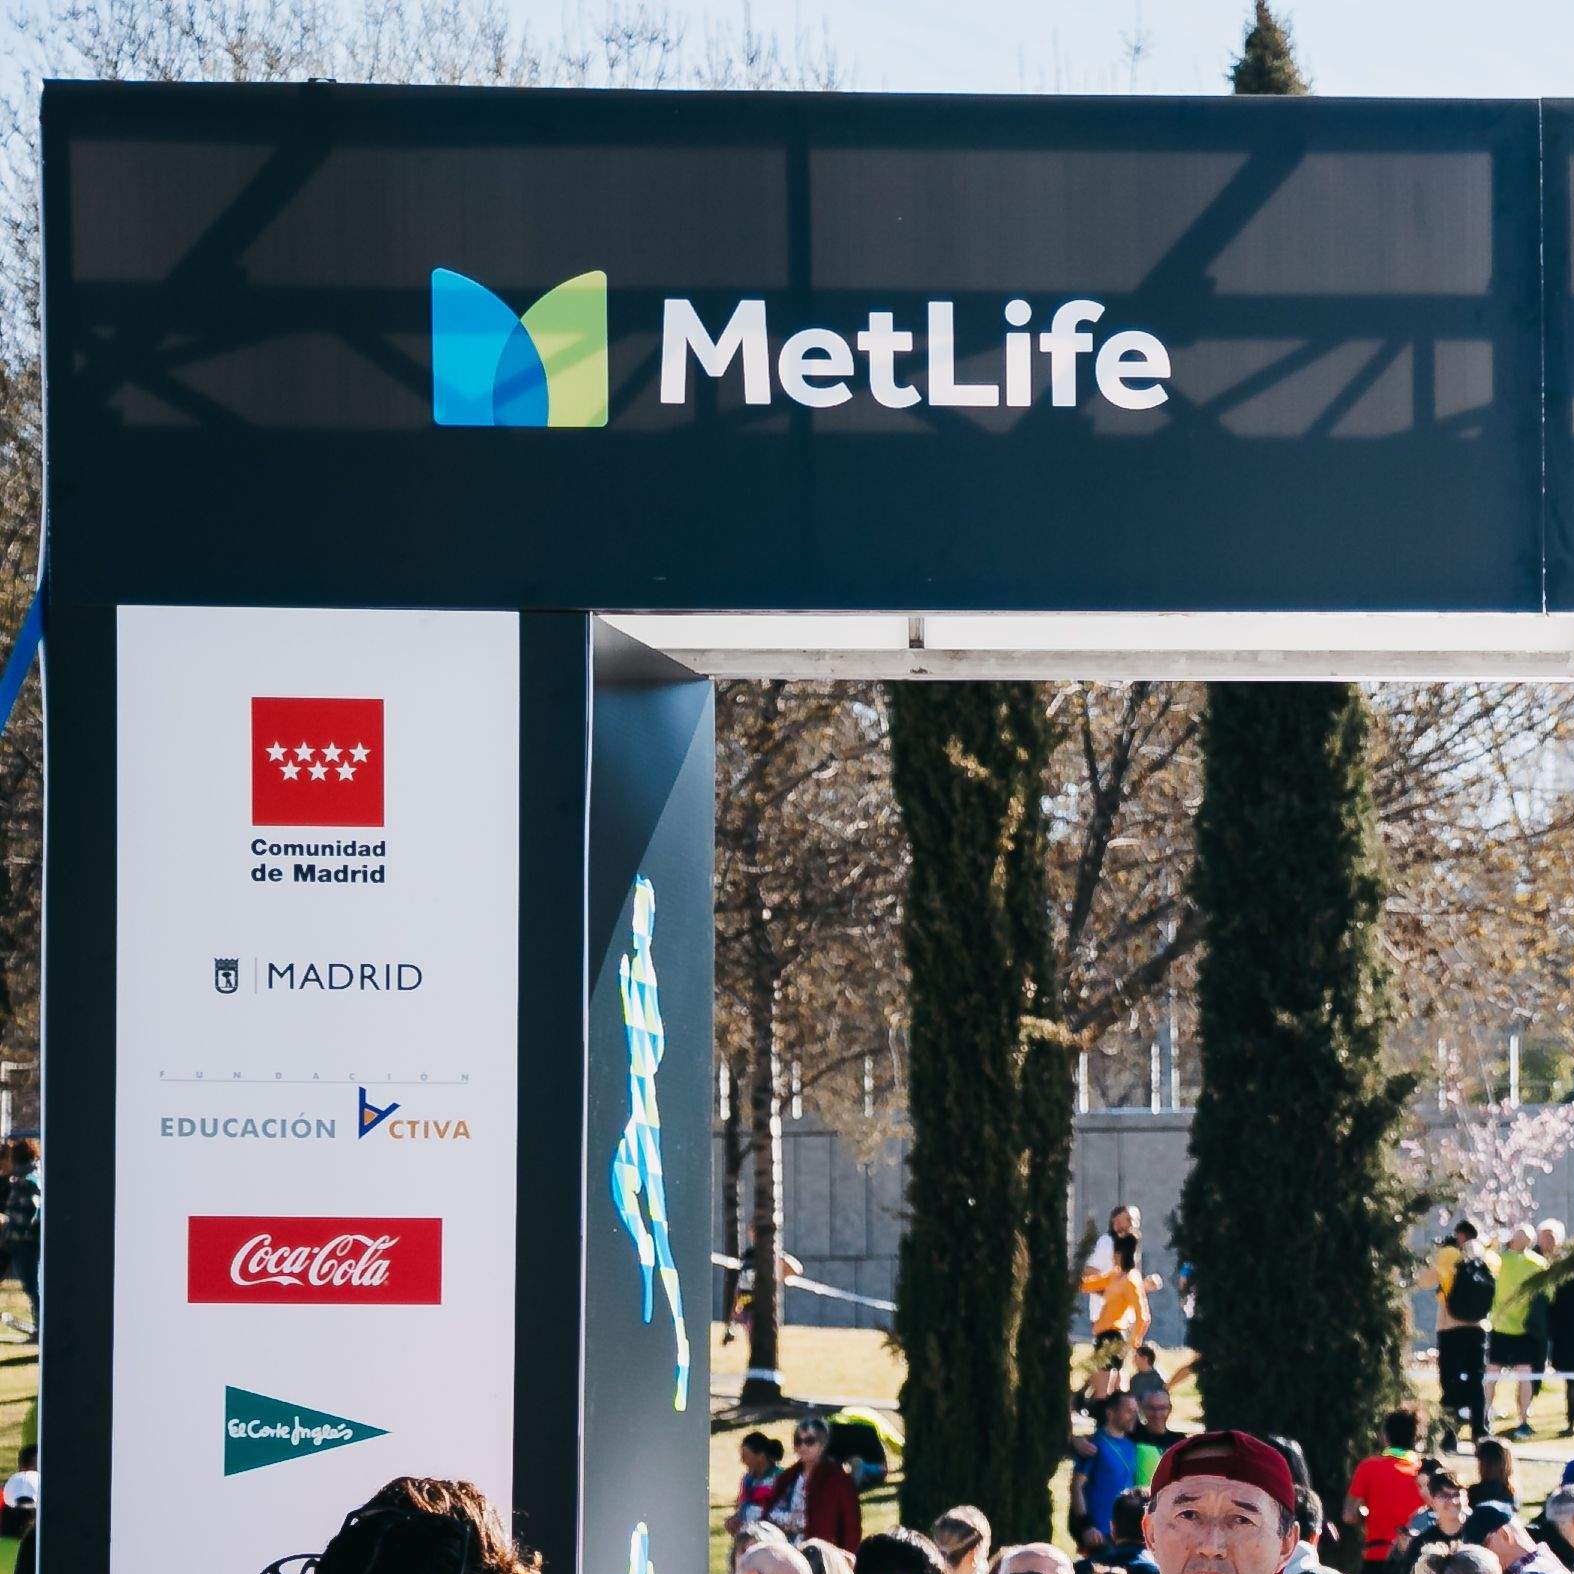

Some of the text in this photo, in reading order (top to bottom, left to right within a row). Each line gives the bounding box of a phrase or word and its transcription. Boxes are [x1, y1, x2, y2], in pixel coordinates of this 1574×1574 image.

[660, 298, 1172, 410] MetLife
[251, 838, 387, 858] Comunidad
[251, 863, 386, 884] de Madrid
[267, 962, 423, 991] MADRID
[160, 1112, 337, 1140] EDUCACIÓN
[230, 1233, 400, 1286] Coca-Cola
[227, 1416, 353, 1446] El Corte Inglés
